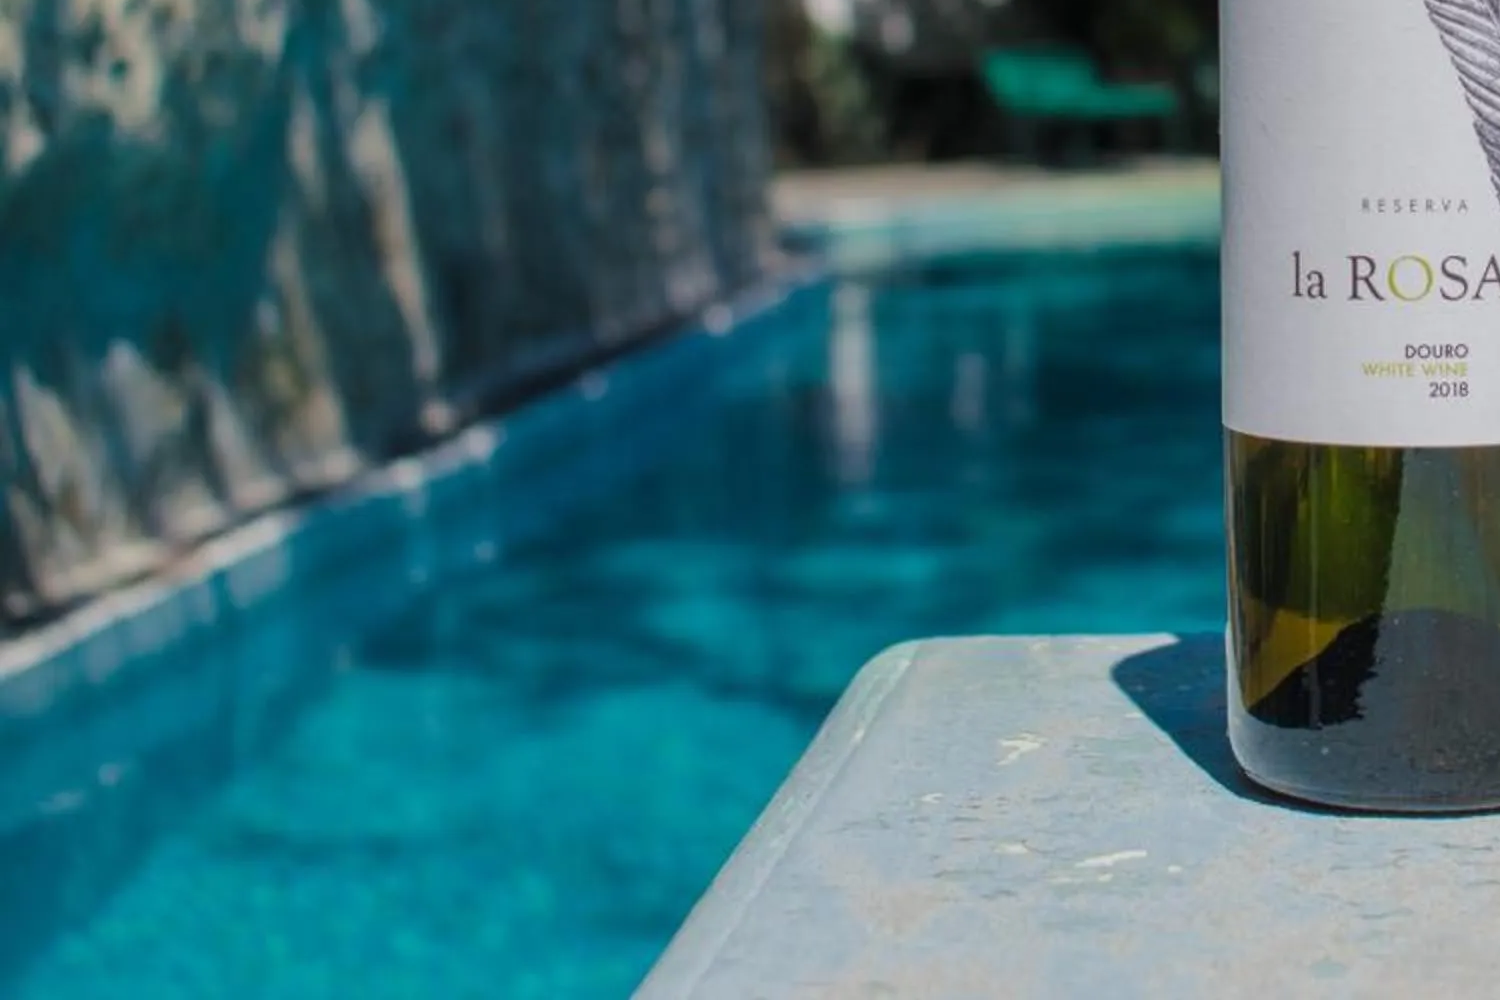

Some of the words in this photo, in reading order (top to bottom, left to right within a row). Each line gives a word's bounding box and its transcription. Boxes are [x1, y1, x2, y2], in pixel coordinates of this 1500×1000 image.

[1361, 198, 1468, 213] RESERVA
[1292, 250, 1328, 300] la
[1404, 343, 1469, 360] DOURO
[1362, 362, 1415, 377] WHITE
[1421, 362, 1468, 377] WINE
[1429, 381, 1469, 398] 2018
